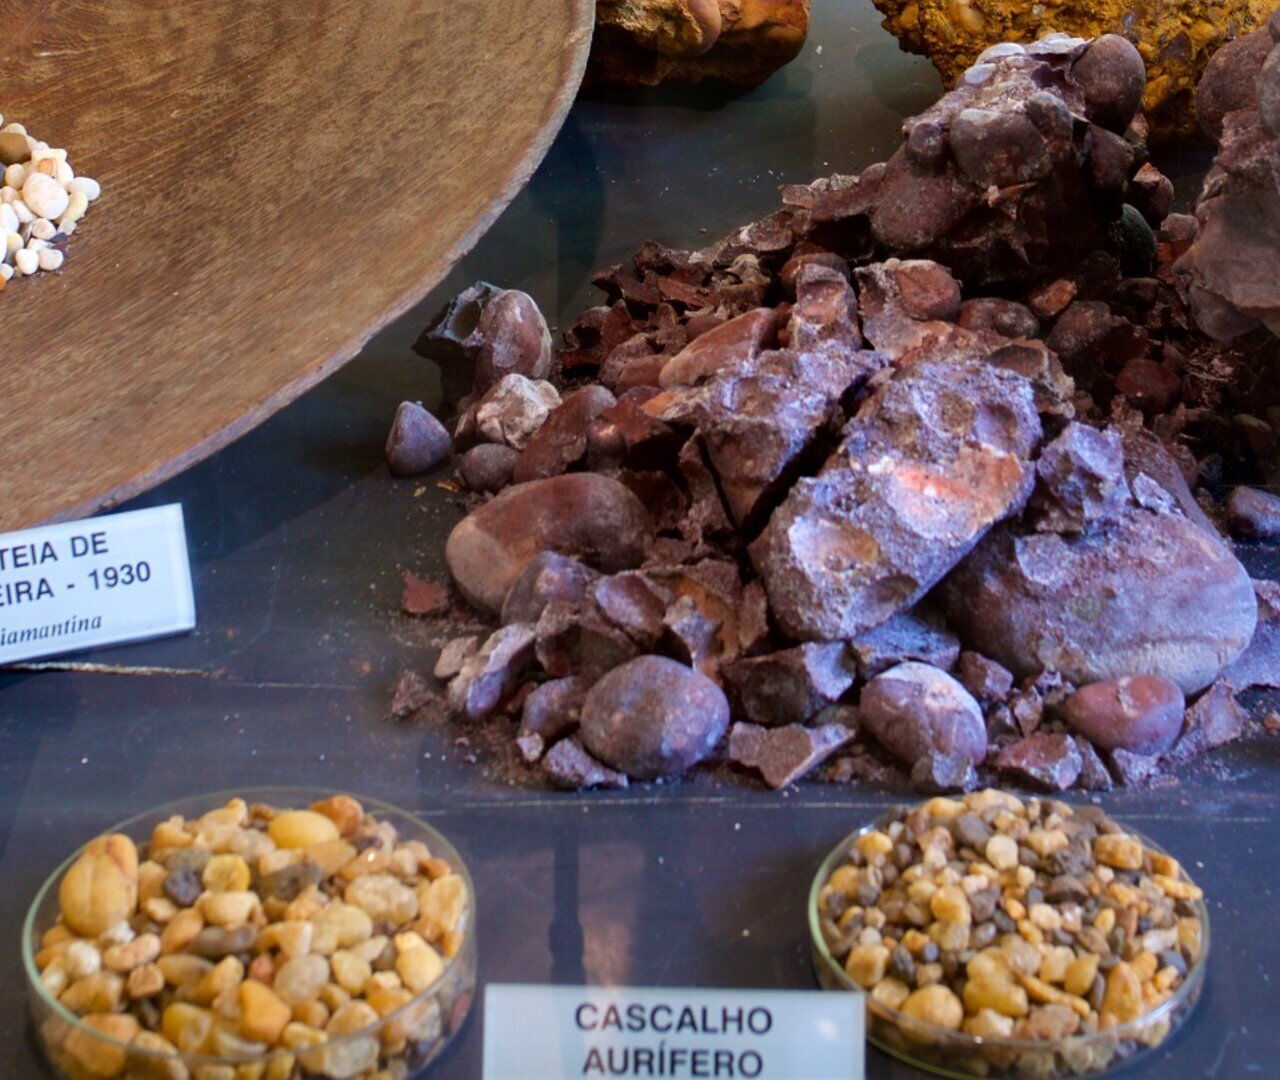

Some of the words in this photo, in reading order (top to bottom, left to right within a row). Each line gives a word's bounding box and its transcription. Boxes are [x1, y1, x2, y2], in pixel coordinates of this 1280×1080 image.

[71, 531, 108, 558] DE
[88, 561, 152, 591] 1930
[575, 1003, 773, 1035] CASCALHO
[582, 1038, 764, 1078] AURÍFERO
